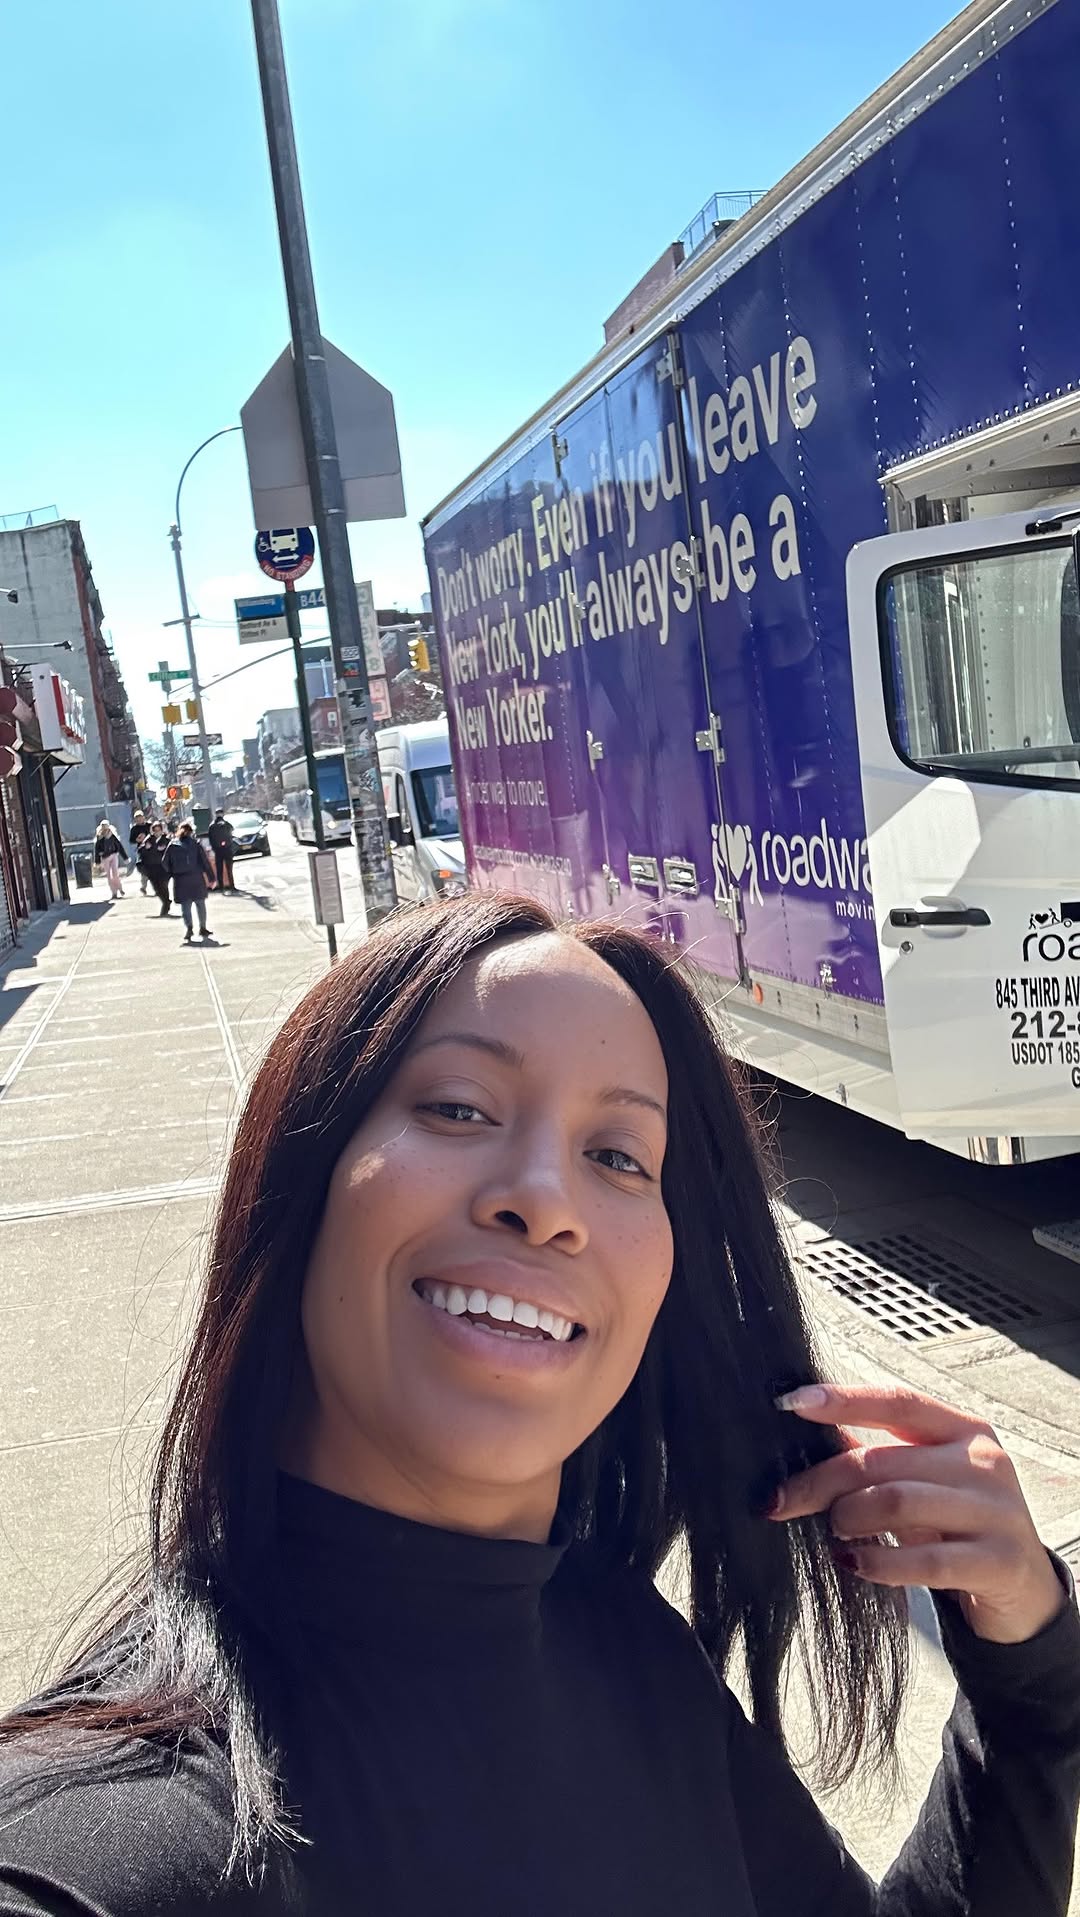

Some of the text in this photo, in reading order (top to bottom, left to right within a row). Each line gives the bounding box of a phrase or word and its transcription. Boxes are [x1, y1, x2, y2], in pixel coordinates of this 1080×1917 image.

[437, 336, 818, 622] Don't worry. Even if you leave
[263, 558, 311, 580] NO STANDING
[300, 589, 327, 608] B44
[445, 631, 479, 687] New
[477, 601, 526, 679] York,
[524, 566, 584, 681] you'll
[586, 541, 693, 645] always
[700, 499, 757, 603] be
[769, 494, 801, 581] a
[454, 697, 488, 750] New
[486, 678, 552, 746] Yorker.
[506, 776, 518, 806] to
[518, 780, 548, 807] move.
[996, 978, 1018, 1008] 845
[1021, 977, 1060, 1008] THIRD
[1011, 1010, 1080, 1039] 212-
[1011, 1041, 1080, 1065] USDOT 185
